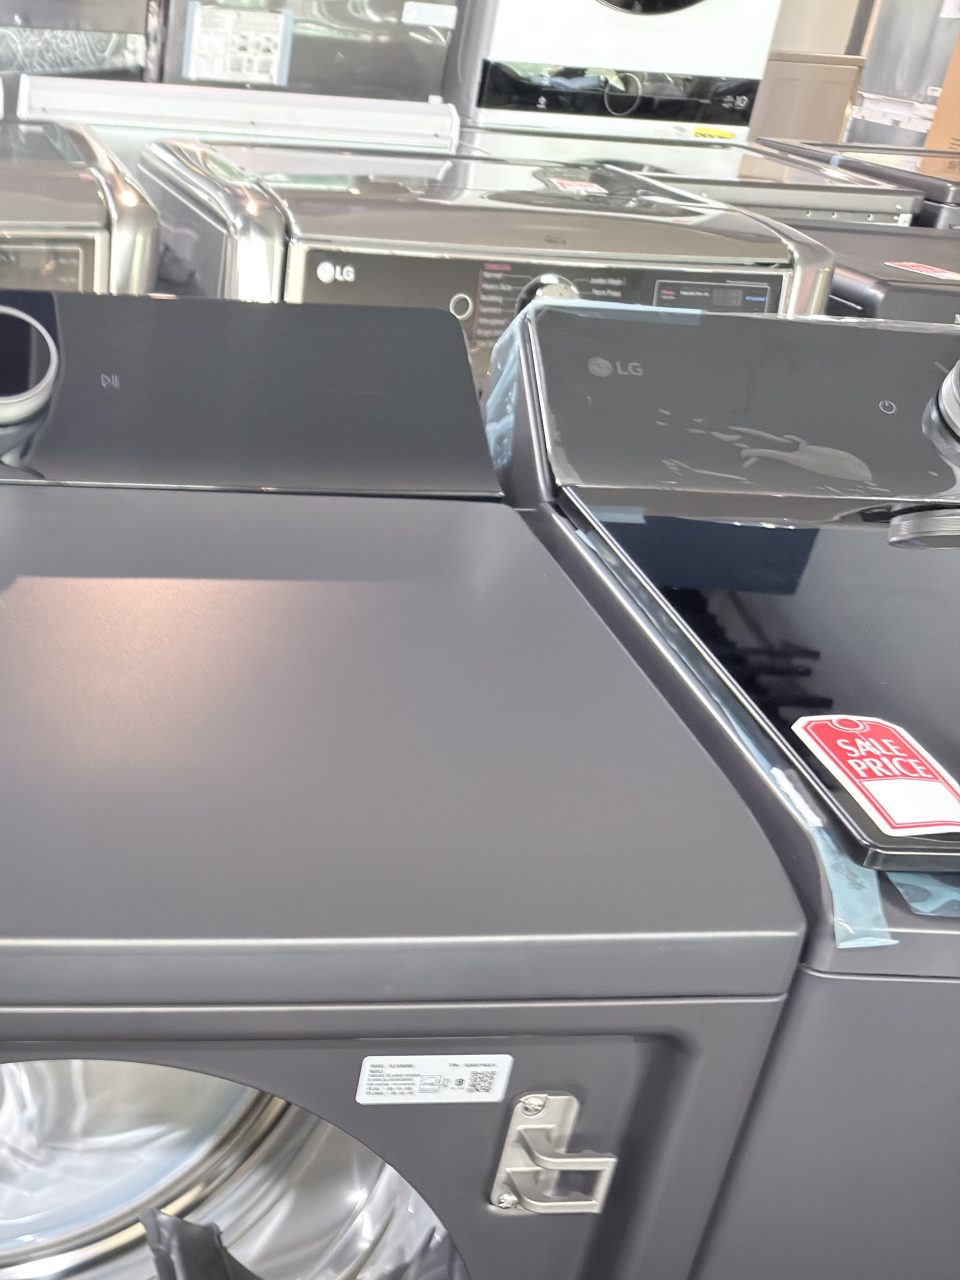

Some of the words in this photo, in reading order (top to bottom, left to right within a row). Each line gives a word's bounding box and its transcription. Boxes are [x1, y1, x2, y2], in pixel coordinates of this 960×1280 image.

[335, 265, 355, 282] LG
[615, 361, 644, 376] LG
[836, 738, 907, 757] SALE
[846, 757, 933, 777] PRICE
